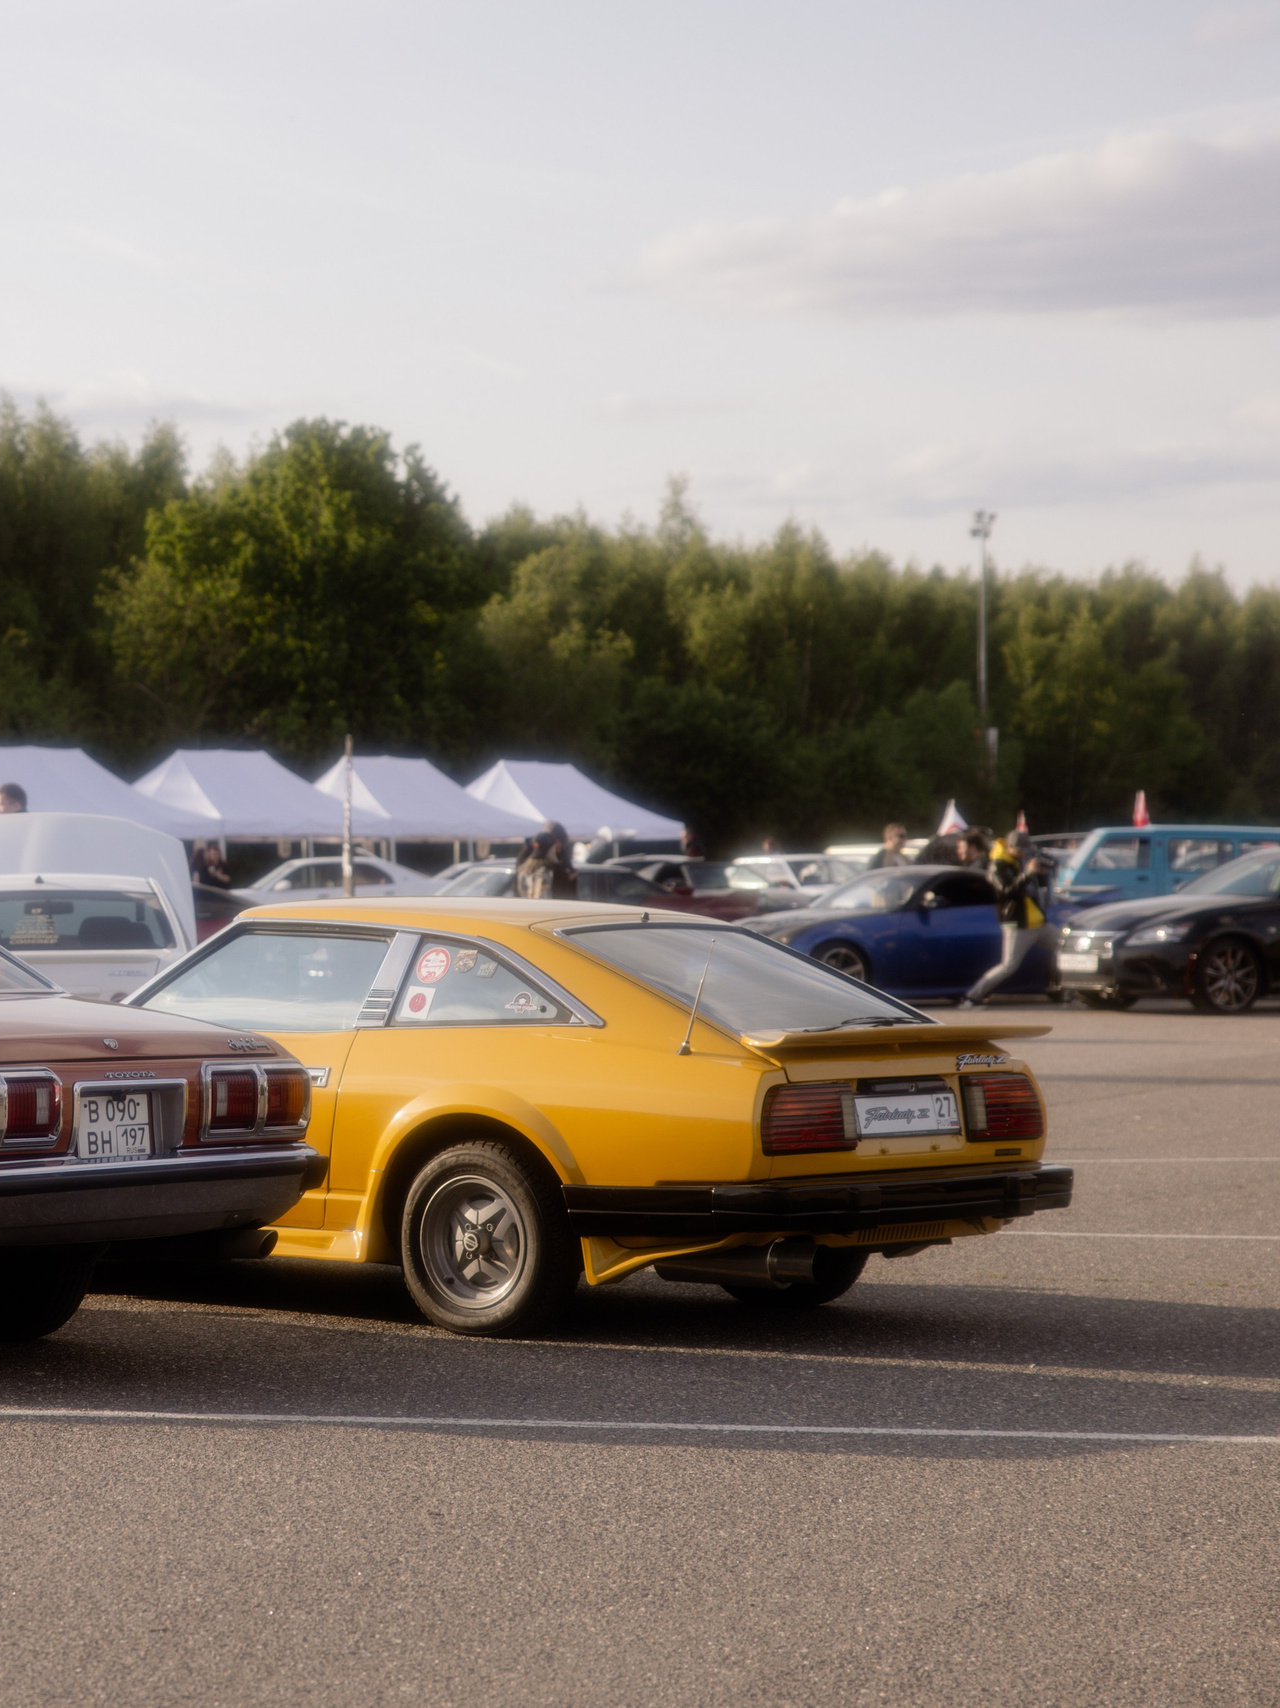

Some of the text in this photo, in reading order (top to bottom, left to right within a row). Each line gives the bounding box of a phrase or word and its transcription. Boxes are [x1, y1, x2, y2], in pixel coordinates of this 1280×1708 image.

[957, 1053, 1007, 1070] Fairlady Z
[106, 1071, 157, 1079] TOYOTA
[105, 1098, 137, 1122] 090
[935, 1096, 952, 1118] 27
[863, 1106, 930, 1129] Fairlady Z
[937, 1119, 951, 1127] RUS
[121, 1127, 146, 1147] 197
